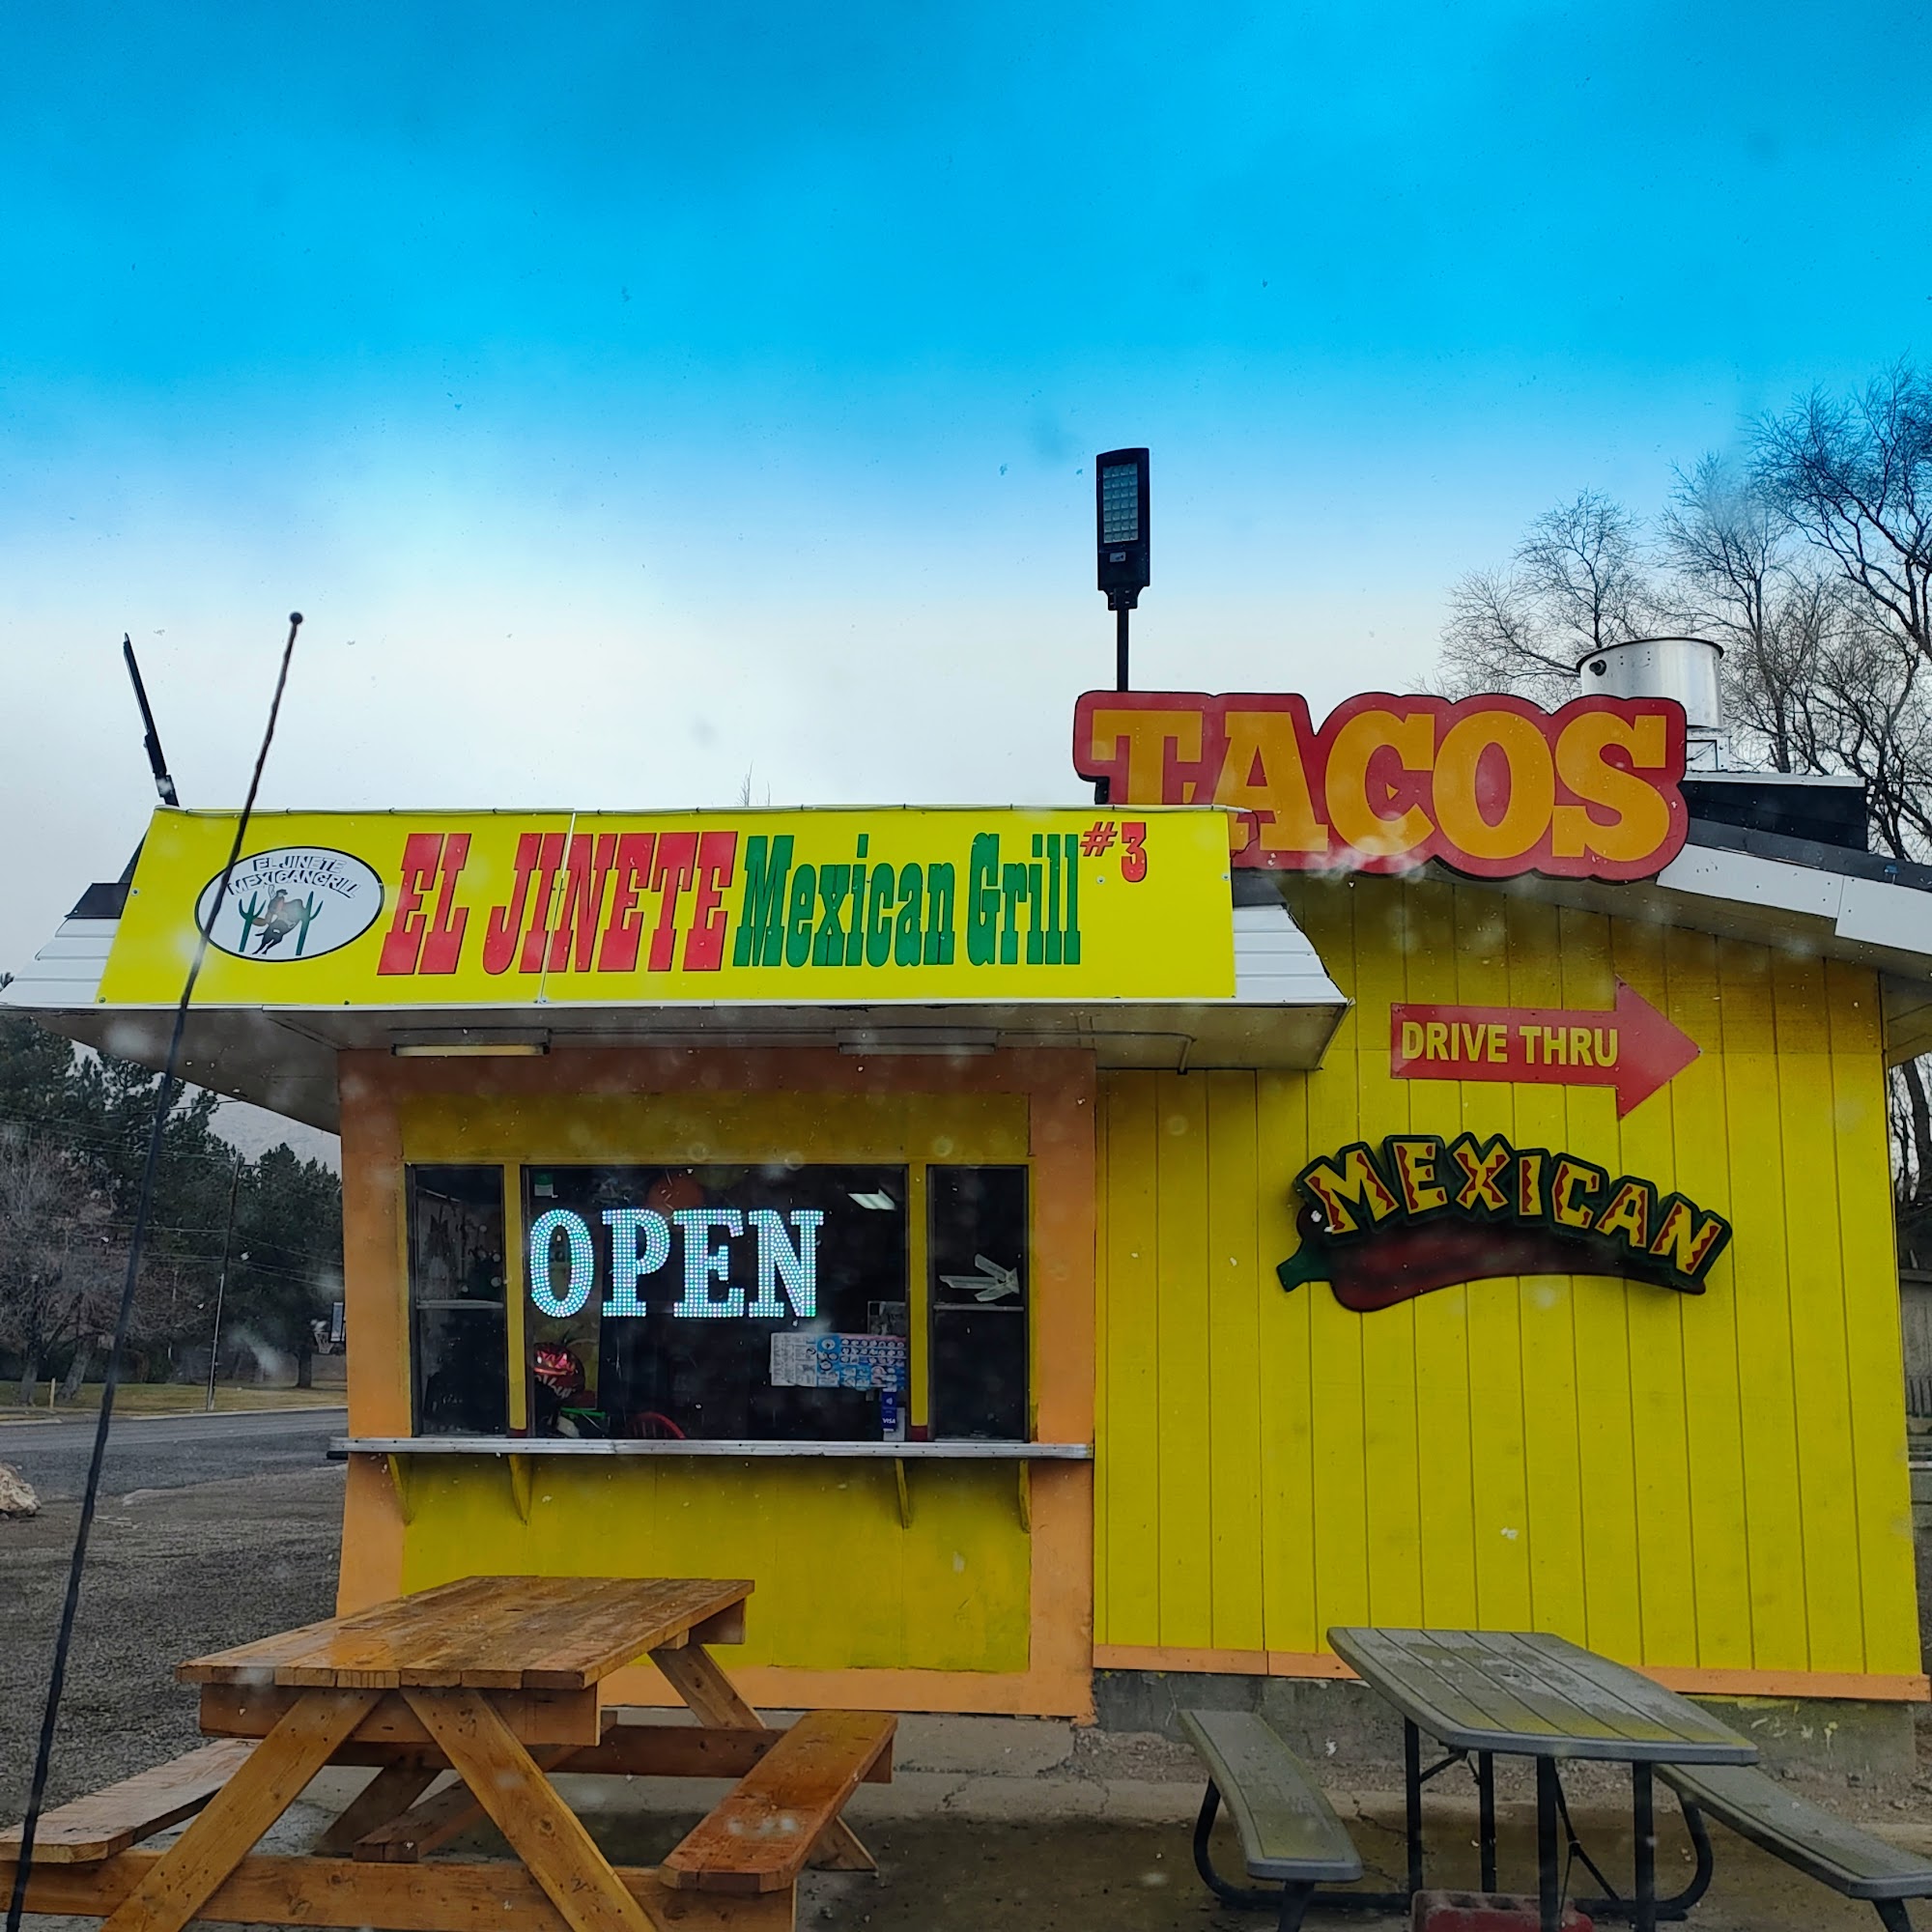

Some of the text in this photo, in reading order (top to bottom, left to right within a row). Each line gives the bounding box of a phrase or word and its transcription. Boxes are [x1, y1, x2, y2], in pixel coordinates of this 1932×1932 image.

[1090, 709, 1670, 862] TACOS
[253, 856, 347, 873] EL JINETE
[377, 833, 471, 976] EL
[483, 831, 738, 976] JINETE
[732, 834, 955, 967] Mexican
[967, 832, 1081, 967] Grill
[1402, 1022, 1619, 1067] DRIVE THRU
[529, 1208, 825, 1318] OPEN
[1301, 1138, 1724, 1277] MEXICAN
